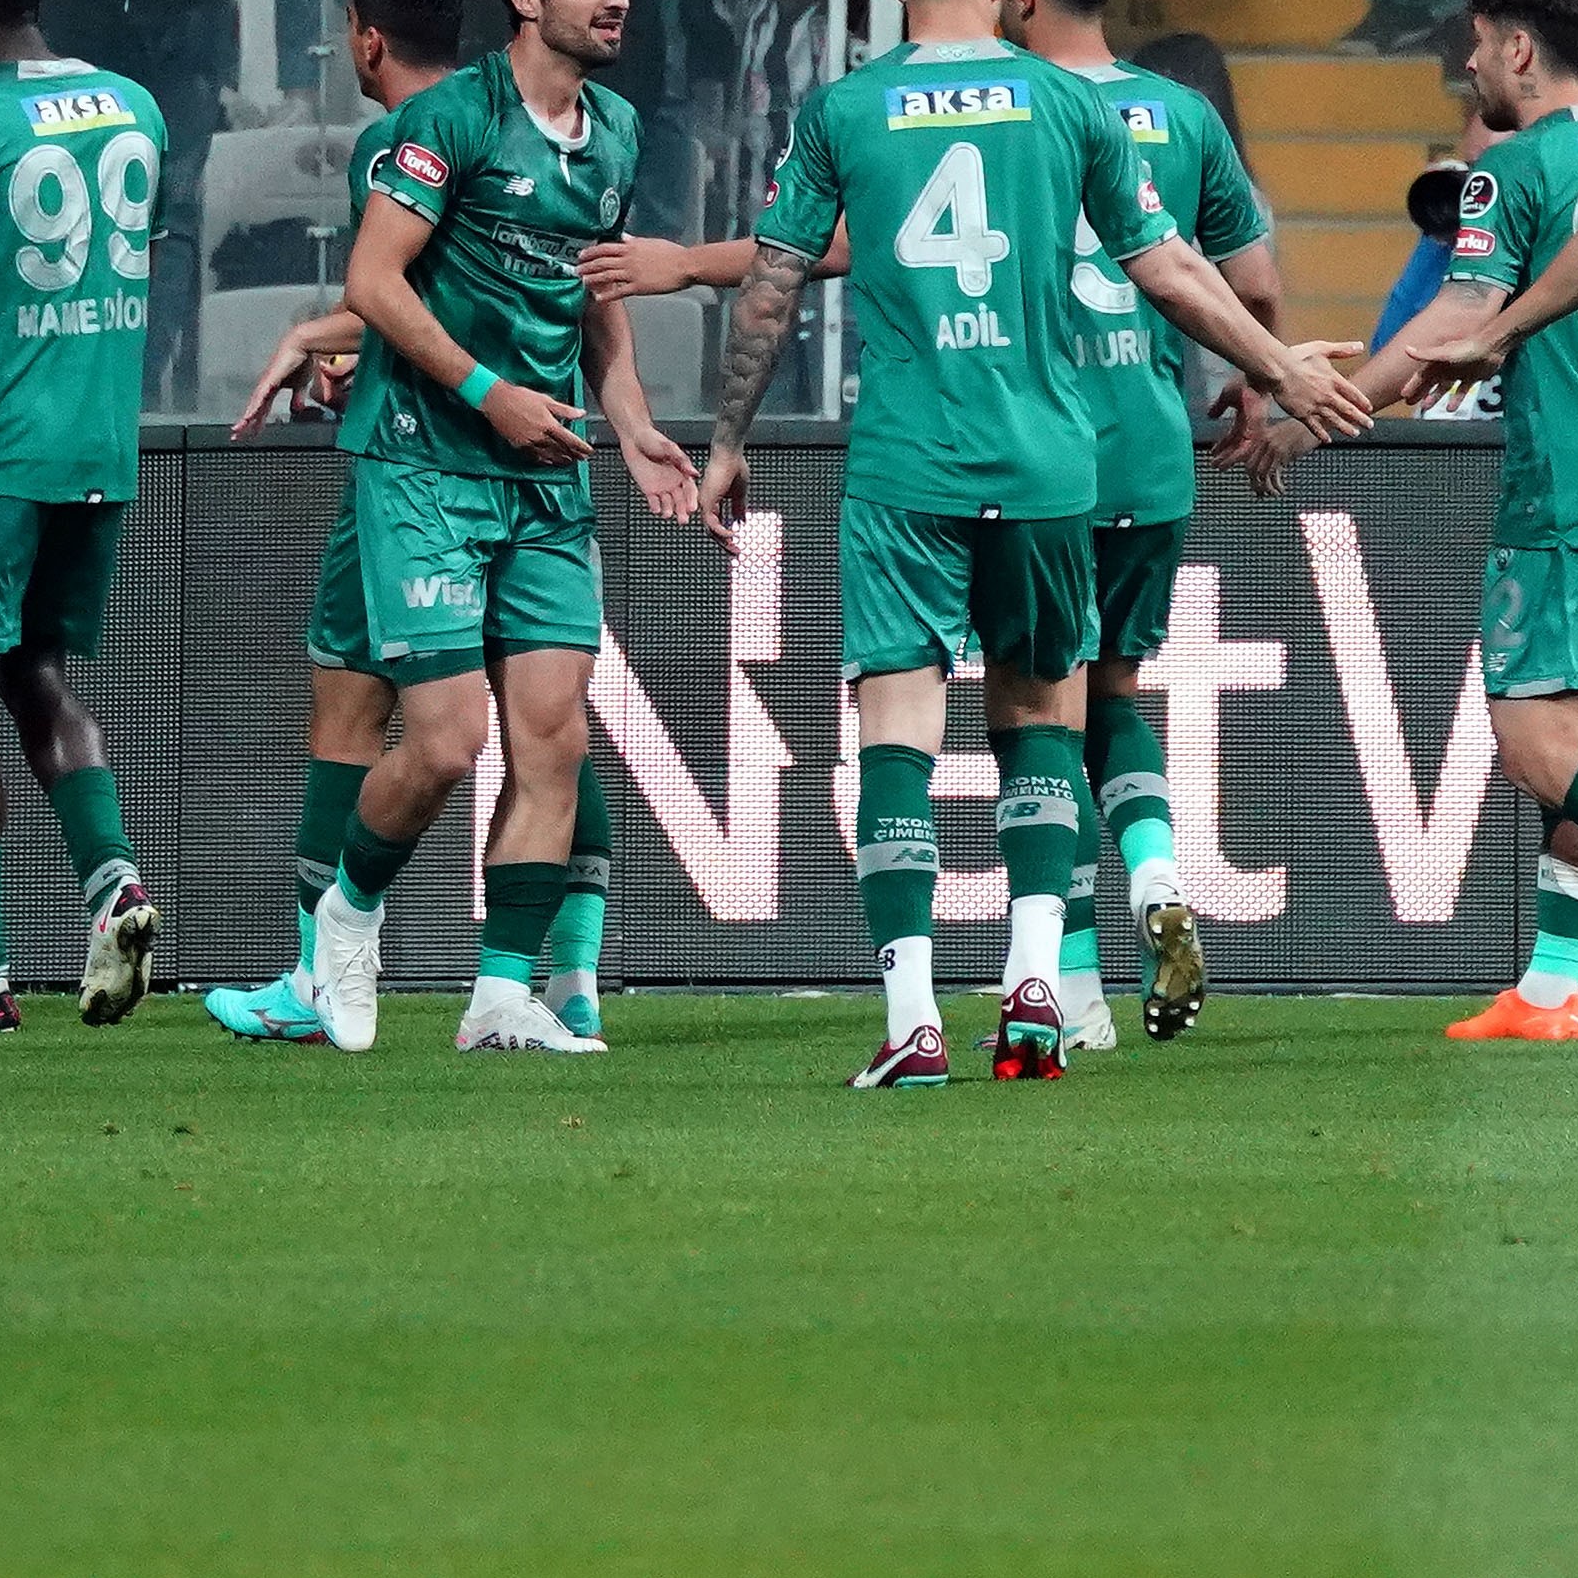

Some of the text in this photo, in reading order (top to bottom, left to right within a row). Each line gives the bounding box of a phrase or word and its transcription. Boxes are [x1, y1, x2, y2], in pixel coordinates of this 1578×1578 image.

[35, 92, 123, 124] aksa
[904, 86, 1013, 117] aksa
[9, 131, 160, 291] 99
[894, 141, 1010, 298] 4
[17, 297, 101, 338] MAME
[935, 302, 1011, 350] ADİL
